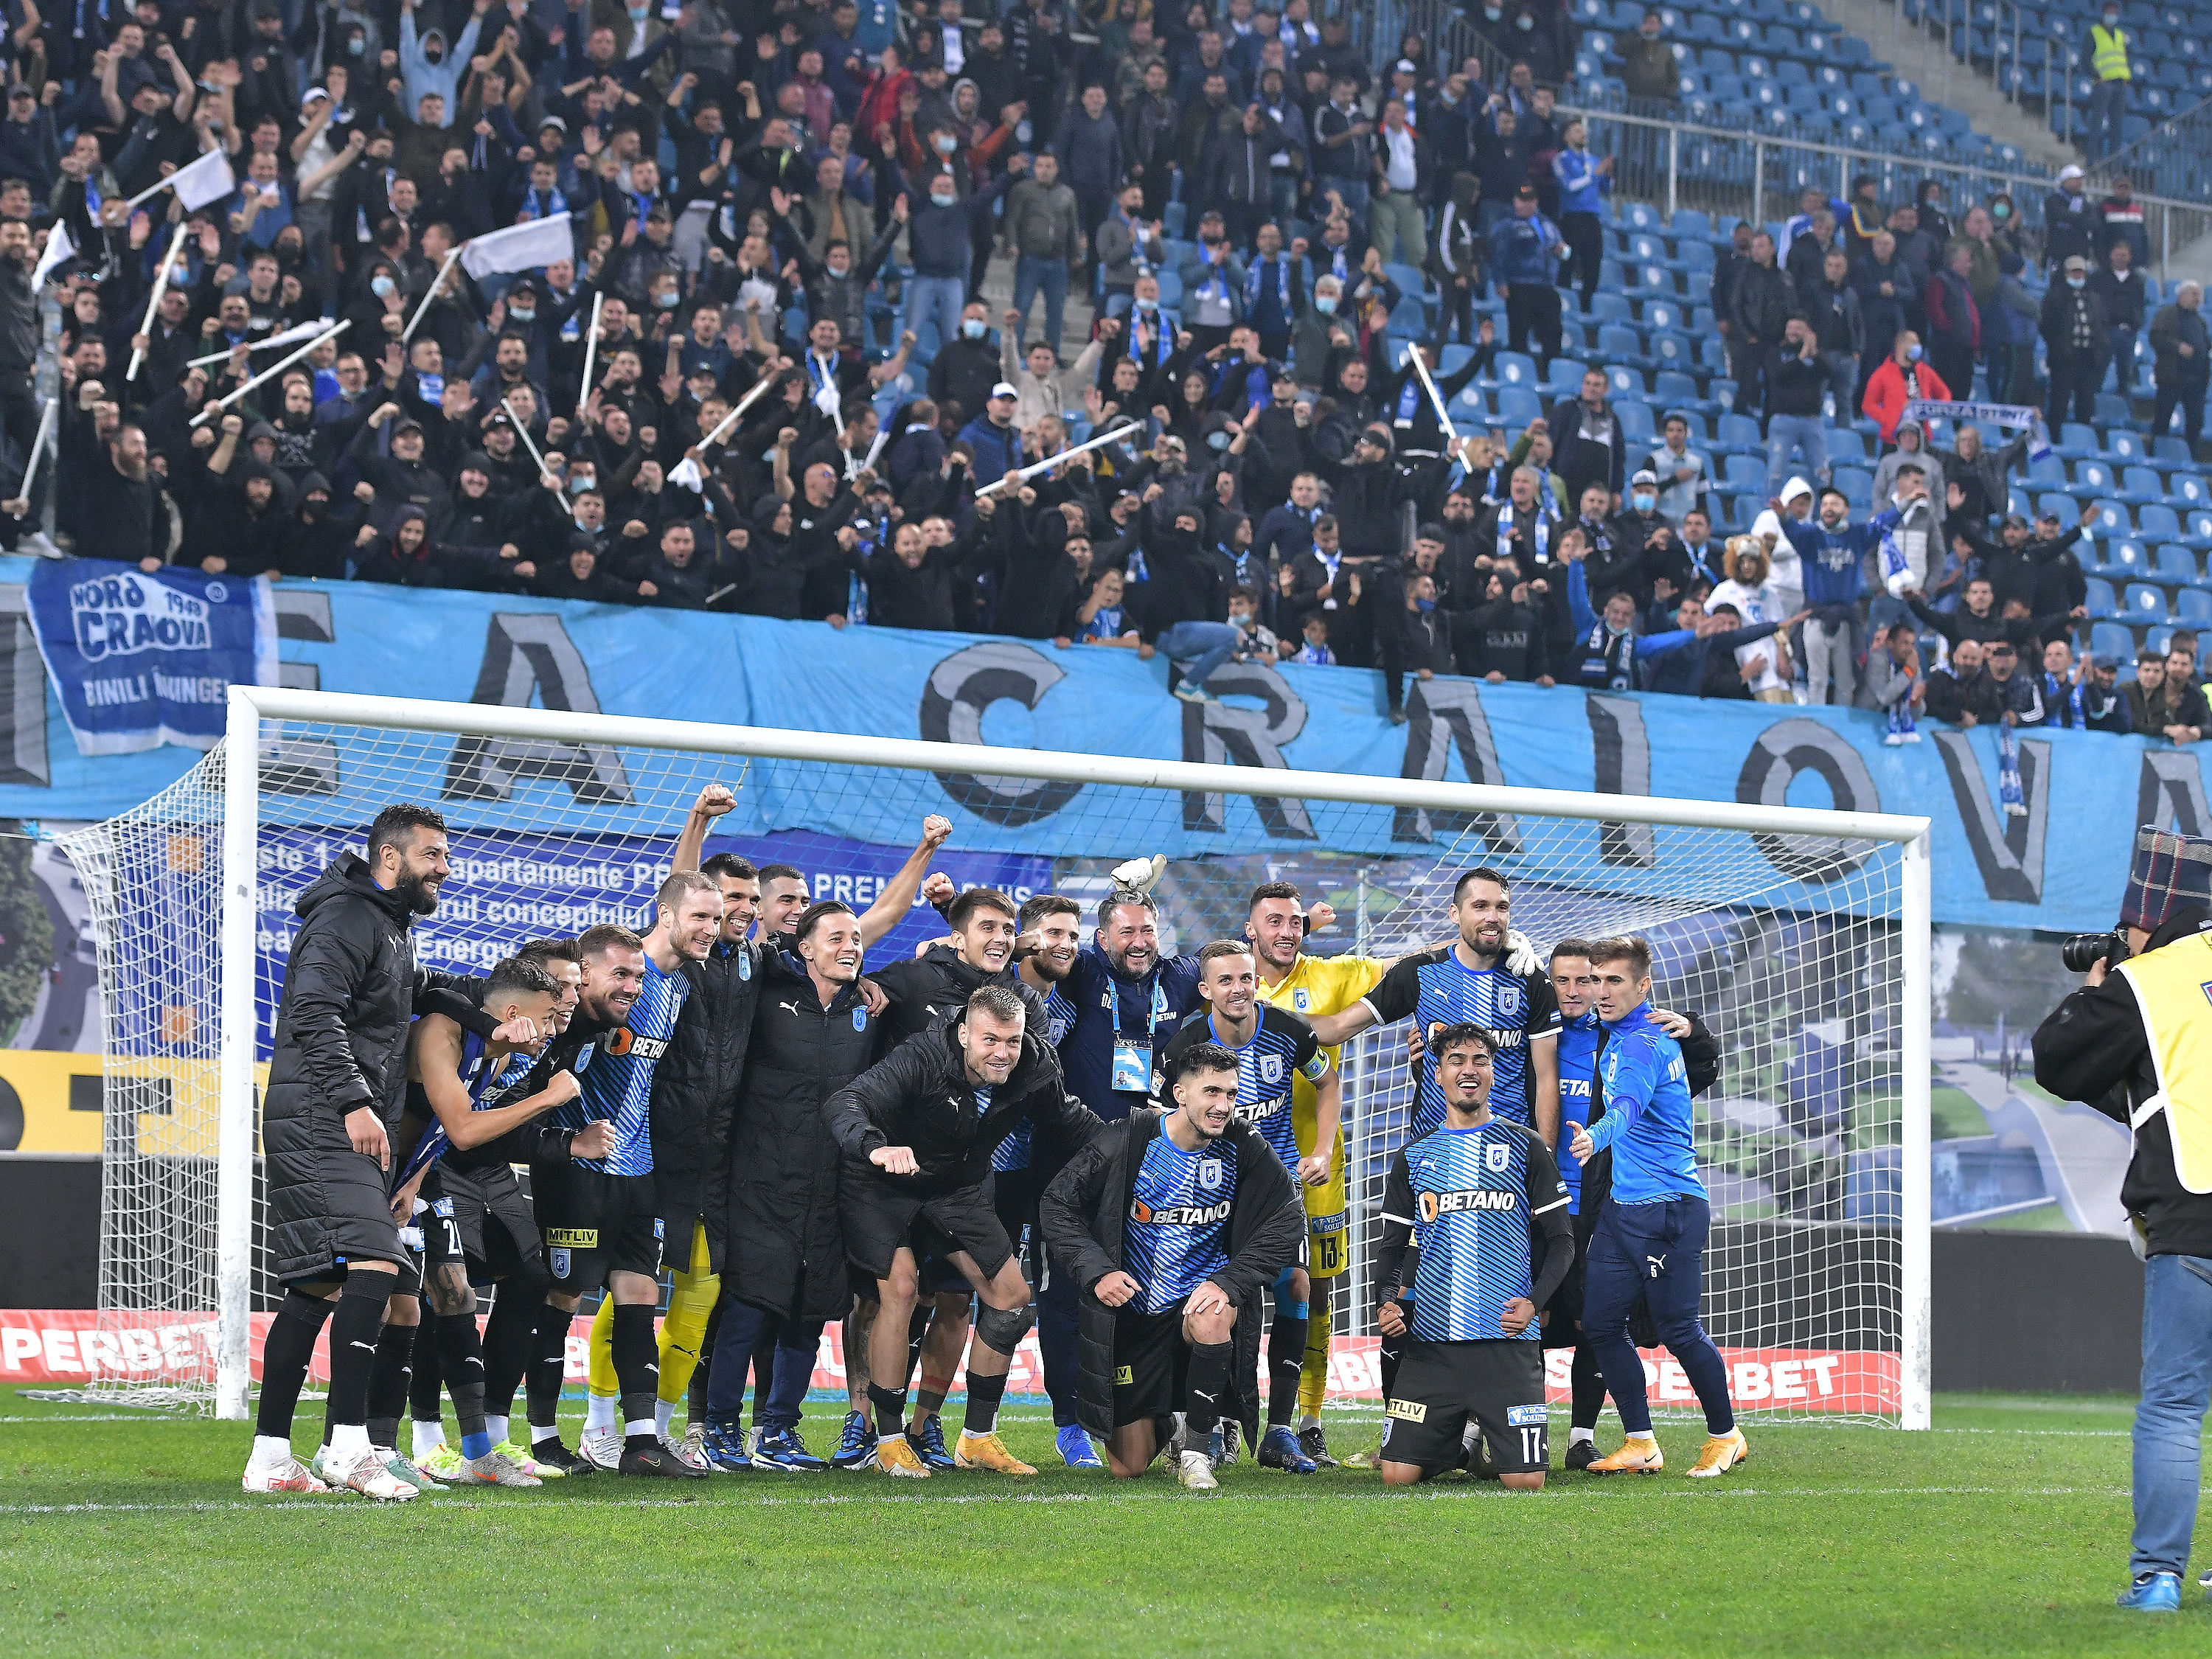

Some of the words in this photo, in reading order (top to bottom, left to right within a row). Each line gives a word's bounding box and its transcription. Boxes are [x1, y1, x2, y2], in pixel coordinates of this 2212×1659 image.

[78, 611, 206, 658] CRAOVA
[451, 857, 624, 889] apartamente
[487, 897, 650, 932] conceptului
[415, 930, 515, 968] Energy
[1155, 1011, 1178, 1023] BETAN
[630, 1036, 669, 1060] BETA
[1559, 1079, 1593, 1097] ETA
[1232, 1091, 1287, 1124] ETANO
[1152, 1200, 1231, 1224] BETANO
[1439, 1190, 1515, 1213] BETANO
[442, 1219, 464, 1256] 2
[549, 1229, 595, 1242] MITLIV
[1319, 1236, 1338, 1270] 13
[1650, 1265, 1658, 1278] 5
[1545, 1348, 1839, 1402] SEBET
[1388, 1400, 1422, 1416] ITLIV
[1520, 1427, 1542, 1464] 17
